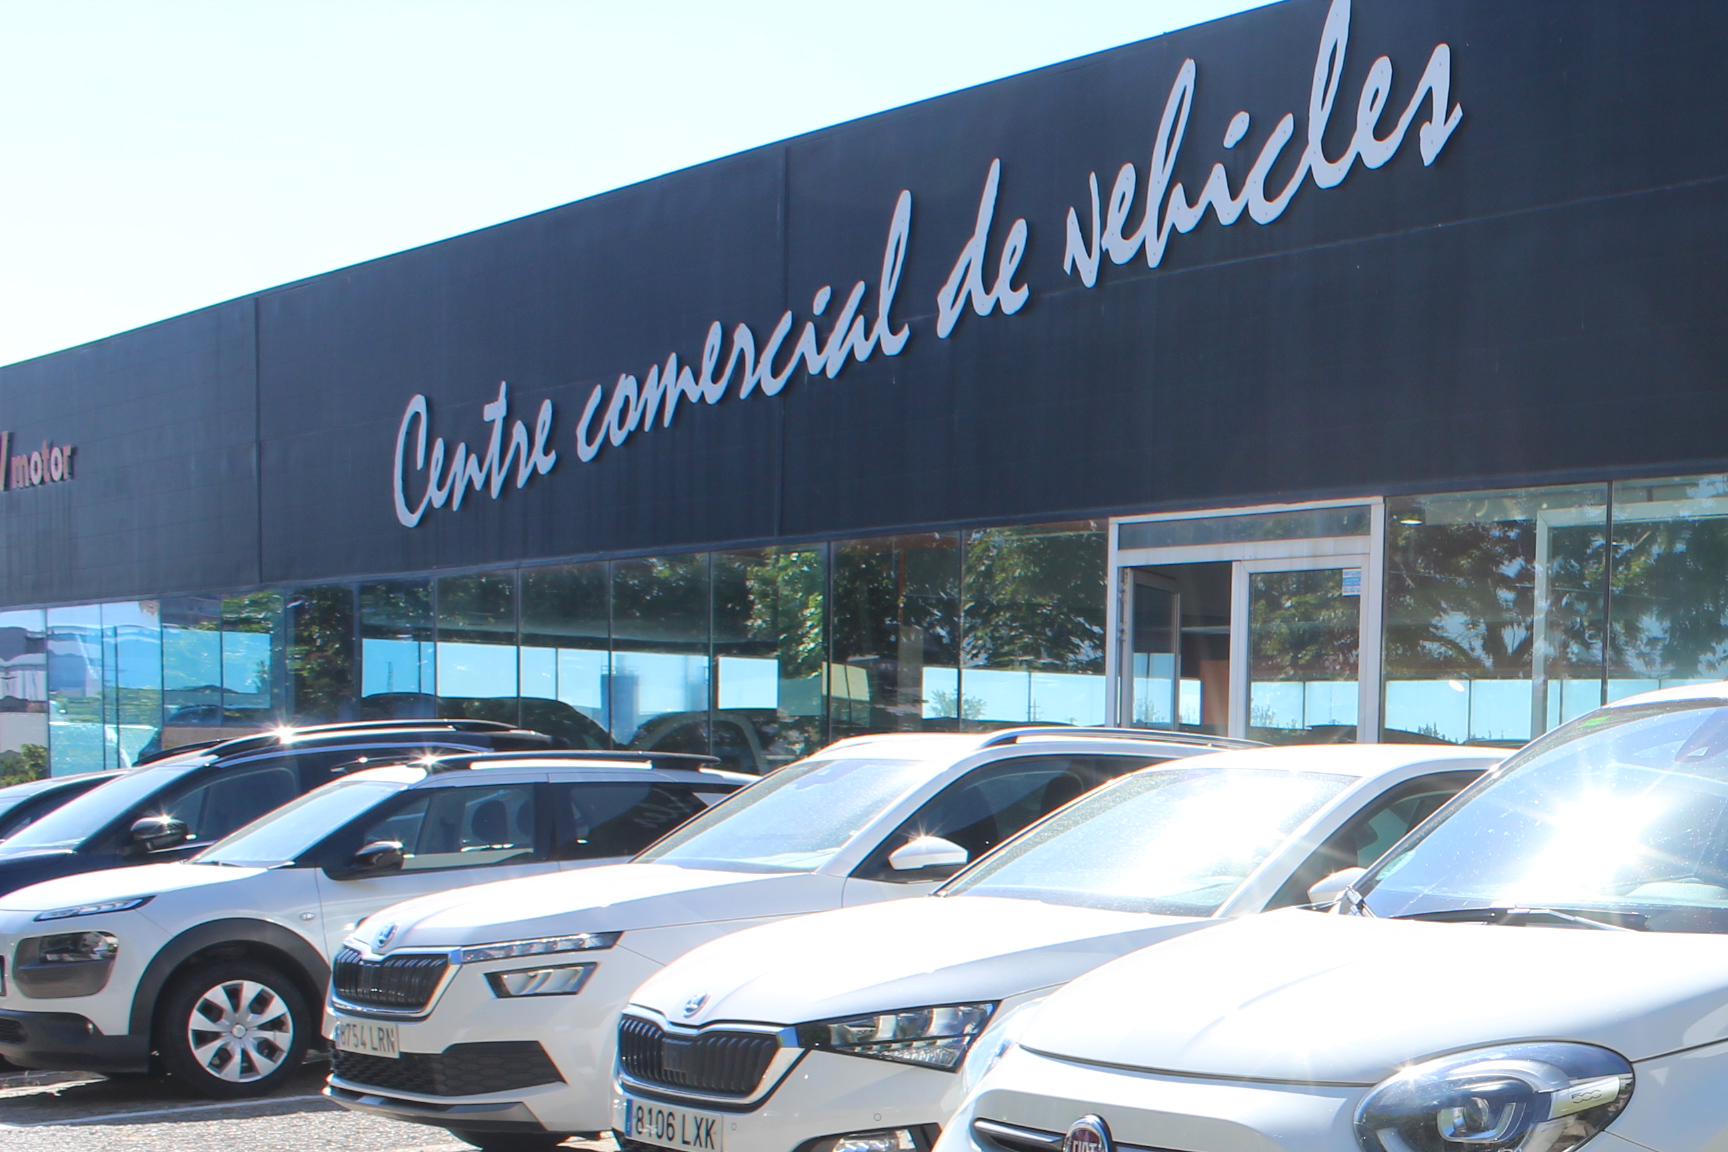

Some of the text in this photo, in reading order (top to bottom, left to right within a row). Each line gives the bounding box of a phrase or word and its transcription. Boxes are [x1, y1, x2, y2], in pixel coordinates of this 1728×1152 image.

[394, 0, 1463, 527] Centre comercial de vehicles
[11, 439, 71, 489] motor
[341, 1022, 396, 1053] 8754 LRN
[1572, 1089, 1602, 1104] 500
[636, 1105, 716, 1151] 8106 LXK
